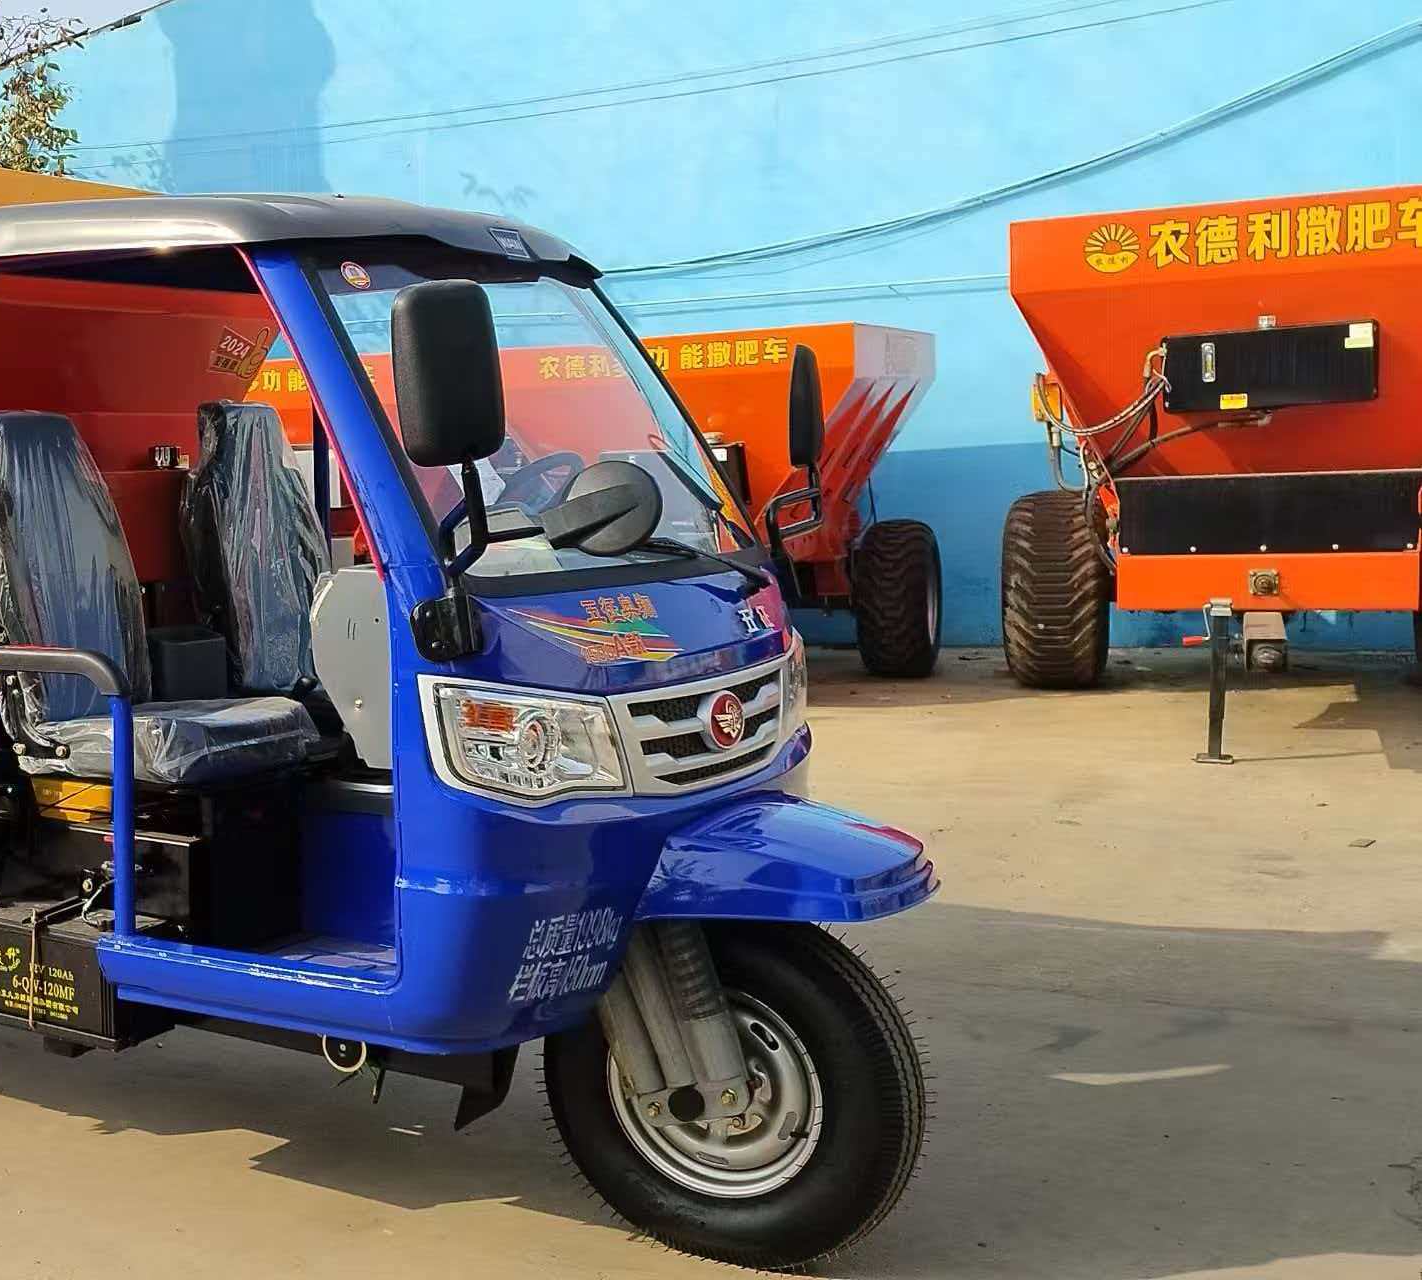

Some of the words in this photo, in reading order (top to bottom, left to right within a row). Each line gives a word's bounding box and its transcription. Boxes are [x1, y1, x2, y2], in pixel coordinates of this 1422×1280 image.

[1149, 196, 1422, 269] 农德利撒肥车
[219, 335, 251, 360] 2024
